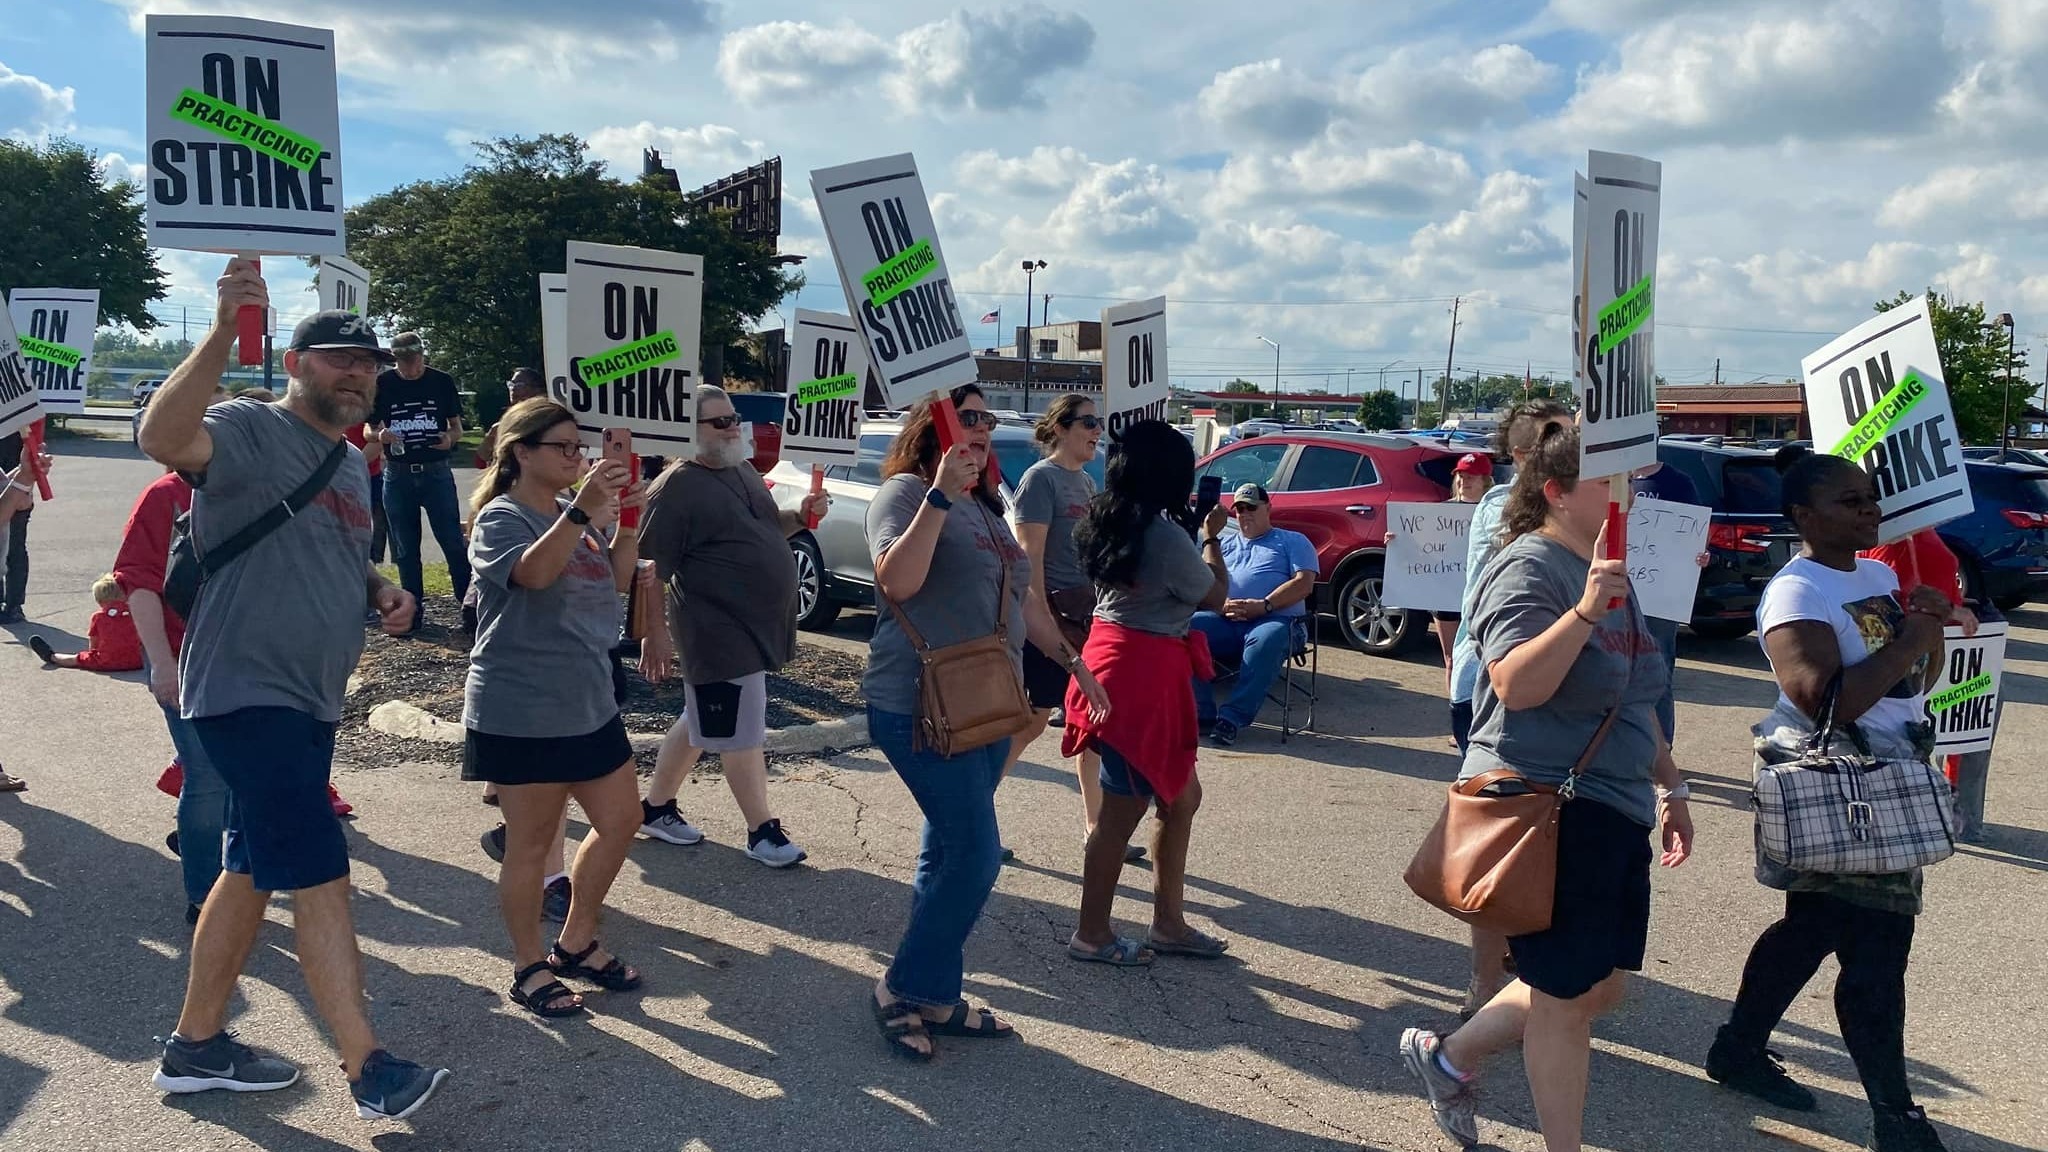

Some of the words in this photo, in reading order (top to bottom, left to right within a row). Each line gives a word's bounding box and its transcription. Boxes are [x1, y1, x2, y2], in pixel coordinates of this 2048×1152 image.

[202, 53, 280, 121] ON
[176, 96, 315, 165] PRACTICING
[152, 139, 335, 213] STRIKE
[860, 196, 915, 264] ON
[1614, 208, 1645, 298] ON
[336, 279, 357, 311] ON
[866, 245, 935, 299] PRACTICING
[30, 309, 69, 344] ON
[604, 282, 659, 342] ON
[862, 278, 964, 363] STRIKE
[1600, 281, 1651, 342] PRACTICING
[24, 356, 87, 391] RIKE
[582, 337, 677, 381] PRACTICING
[814, 337, 848, 381] ON
[1128, 332, 1154, 389] ON
[1586, 332, 1656, 424] STRIKE
[570, 356, 691, 424] STRIKE
[799, 376, 857, 400] PRACTICING
[1838, 350, 1896, 427] ON
[786, 393, 860, 440] STRIKE
[1862, 414, 1959, 501] RIKE
[1422, 542, 1447, 555] our
[1436, 515, 1471, 537] Supp
[1674, 514, 1708, 537] IN
[1408, 559, 1467, 575] teacher
[1949, 647, 1984, 685] ON
[1923, 693, 1996, 734] STRIKE
[1932, 675, 1991, 709] PRACTICING
